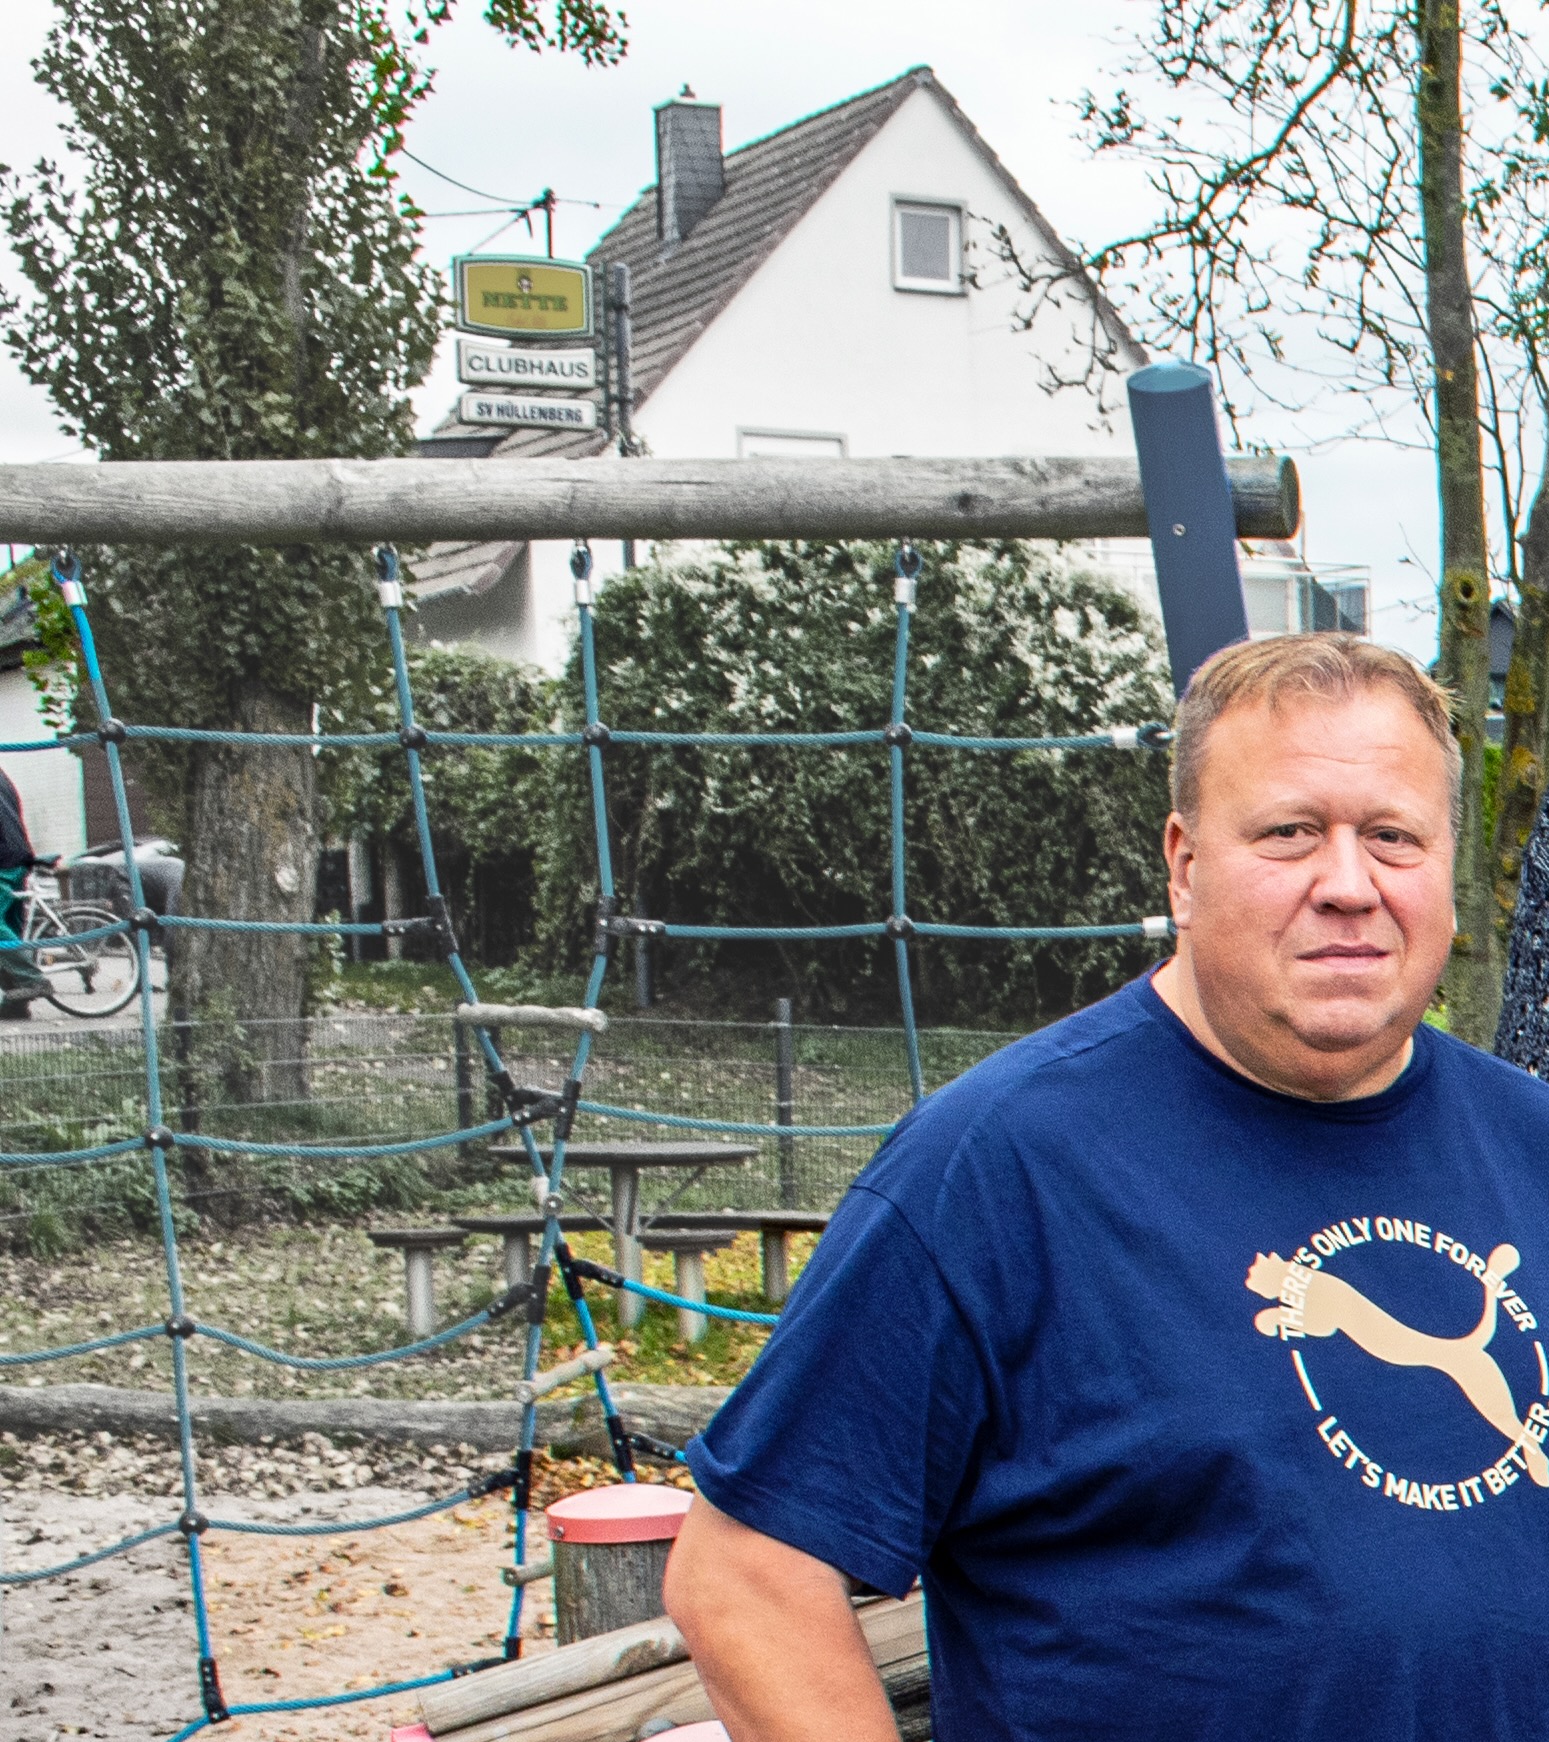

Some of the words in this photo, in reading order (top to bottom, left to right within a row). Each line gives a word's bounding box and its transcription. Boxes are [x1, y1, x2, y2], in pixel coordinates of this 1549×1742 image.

[468, 355, 589, 378] CLUBHAUS
[477, 402, 493, 417] SV
[496, 401, 583, 422] HÜLLENBERG
[1279, 1247, 1322, 1341] THERE'S
[1310, 1216, 1373, 1256] ONLY
[1375, 1216, 1432, 1249] ONE
[1434, 1231, 1538, 1332] FOREVER
[1317, 1416, 1383, 1488] LET'S
[1384, 1472, 1460, 1511] MAKE
[1458, 1477, 1485, 1507] IT
